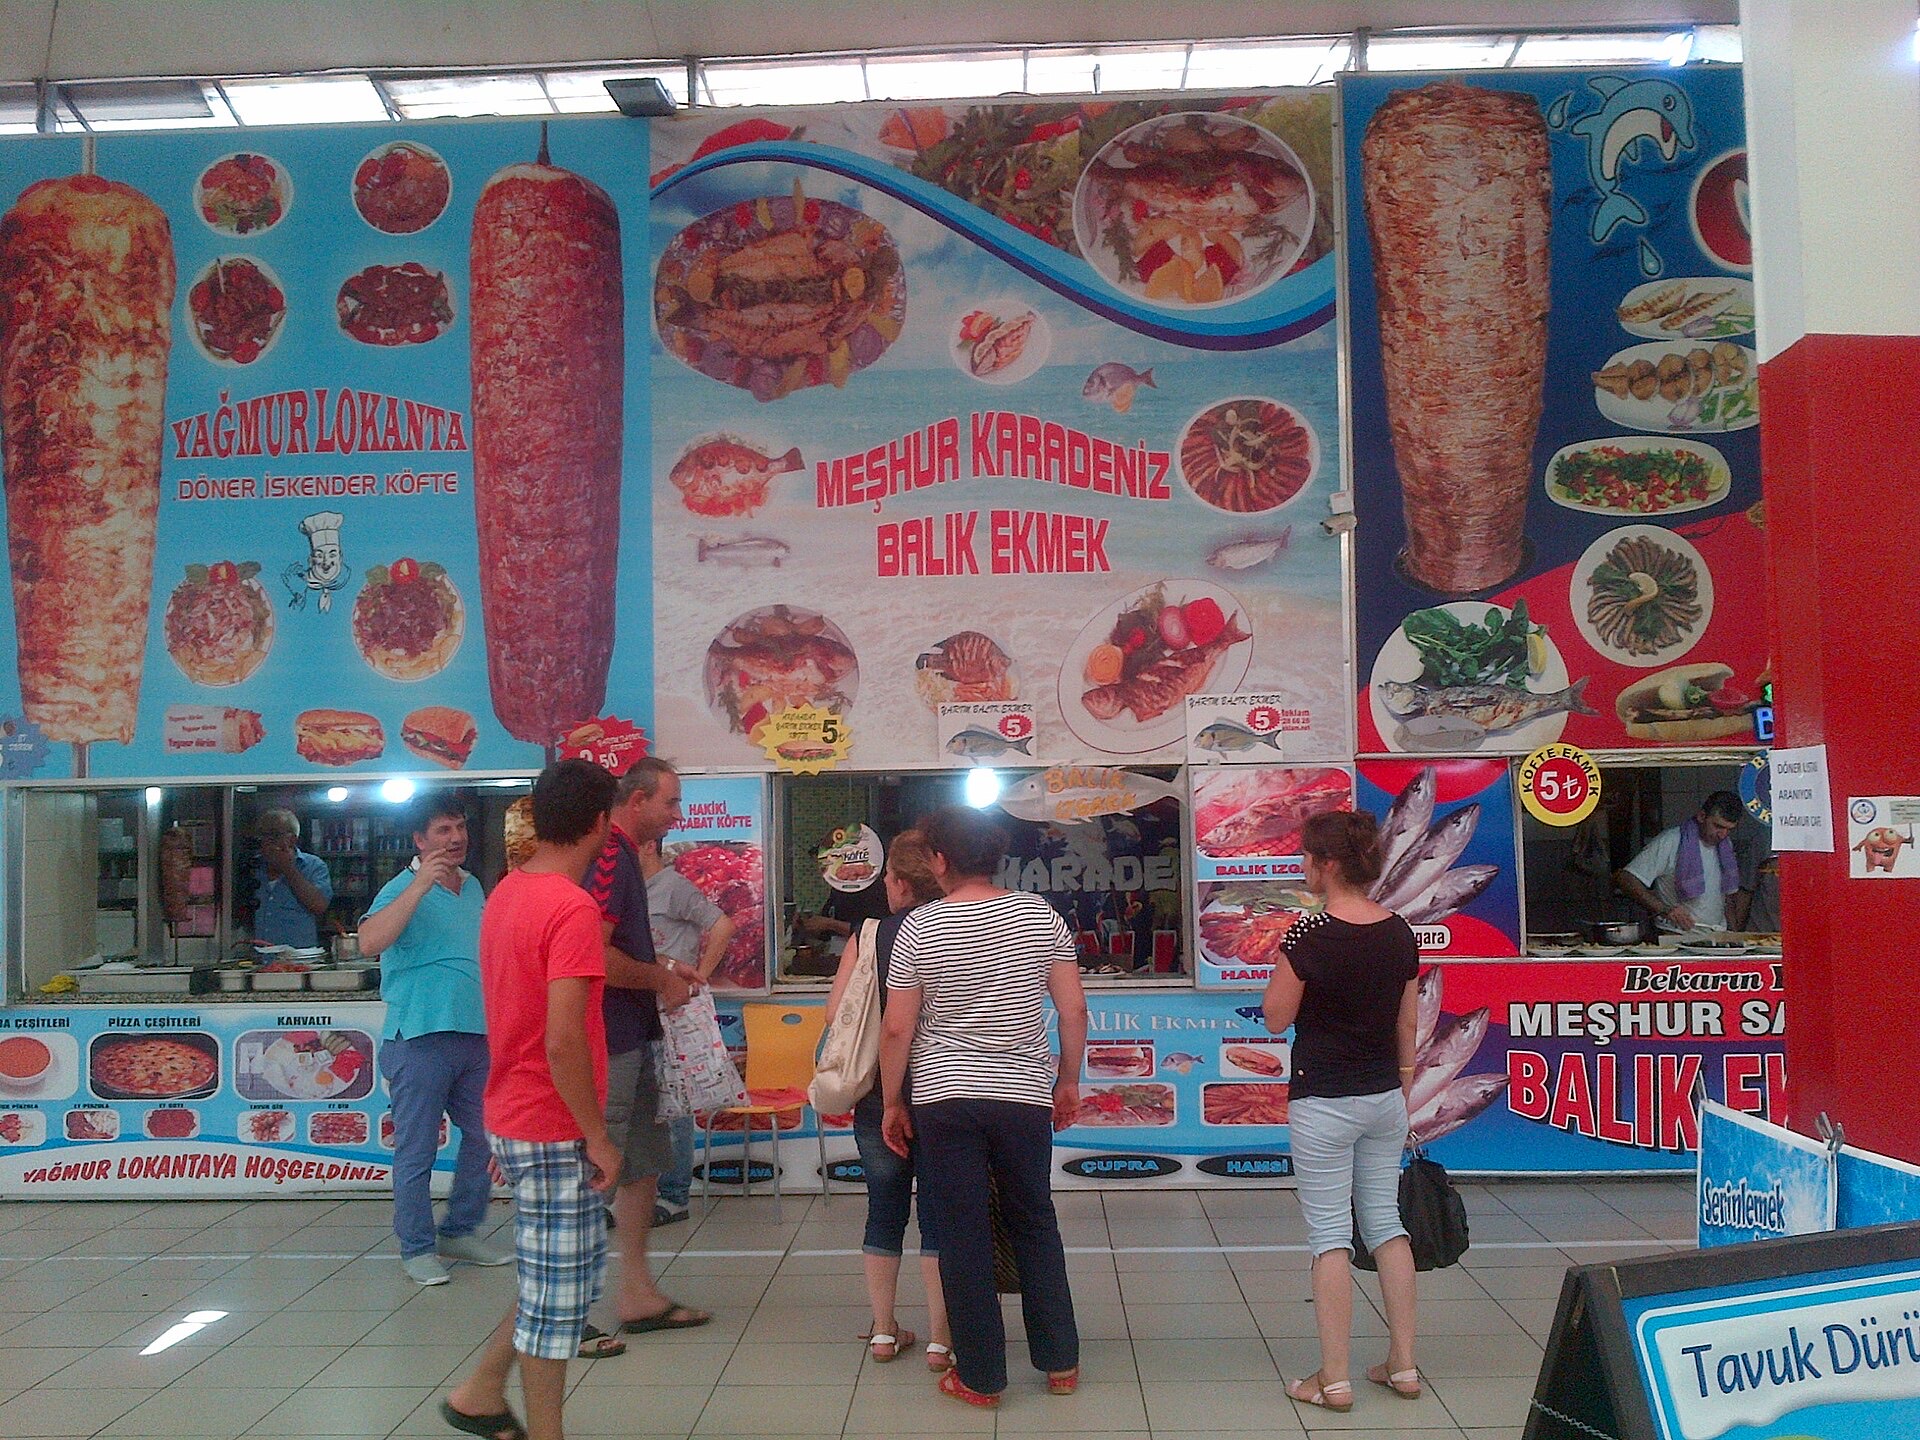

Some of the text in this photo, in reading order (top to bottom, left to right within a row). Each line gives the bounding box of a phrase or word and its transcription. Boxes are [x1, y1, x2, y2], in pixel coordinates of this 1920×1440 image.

[171, 387, 468, 459] YAĞMUR LOKANTA
[816, 410, 1172, 515] MEŞHUR KARADENİZ
[876, 509, 1112, 578] BALIK EKMEK
[1005, 718, 1021, 736] 5
[1255, 711, 1271, 729] 5
[1043, 767, 1128, 793] BALIK
[1522, 747, 1599, 797] KÖFTE EKMEK
[688, 800, 727, 815] HAKİKİ
[717, 814, 752, 828] KÖFTE
[1215, 863, 1305, 876] BALIK IZG
[1621, 965, 1764, 994] Bekarın
[15, 1017, 70, 1029] ÇEŞİTLERİ
[108, 1015, 202, 1029] PİZZA ÇEŞİTLERİ
[276, 1015, 333, 1027] KAHVALTI
[1151, 1014, 1242, 1030] EKMEK
[1507, 1000, 1724, 1046] MEŞHUR
[1506, 1049, 1702, 1153] BALIK
[23, 1153, 390, 1185] YAĞMUR LOKANTAYA HOŞGELDİNİZ
[1080, 1159, 1161, 1174] ÇUPRA
[1226, 1158, 1289, 1174] HAMSİ
[1703, 1177, 1787, 1234] Serinlemek
[1681, 1326, 1820, 1399] Tavuk
